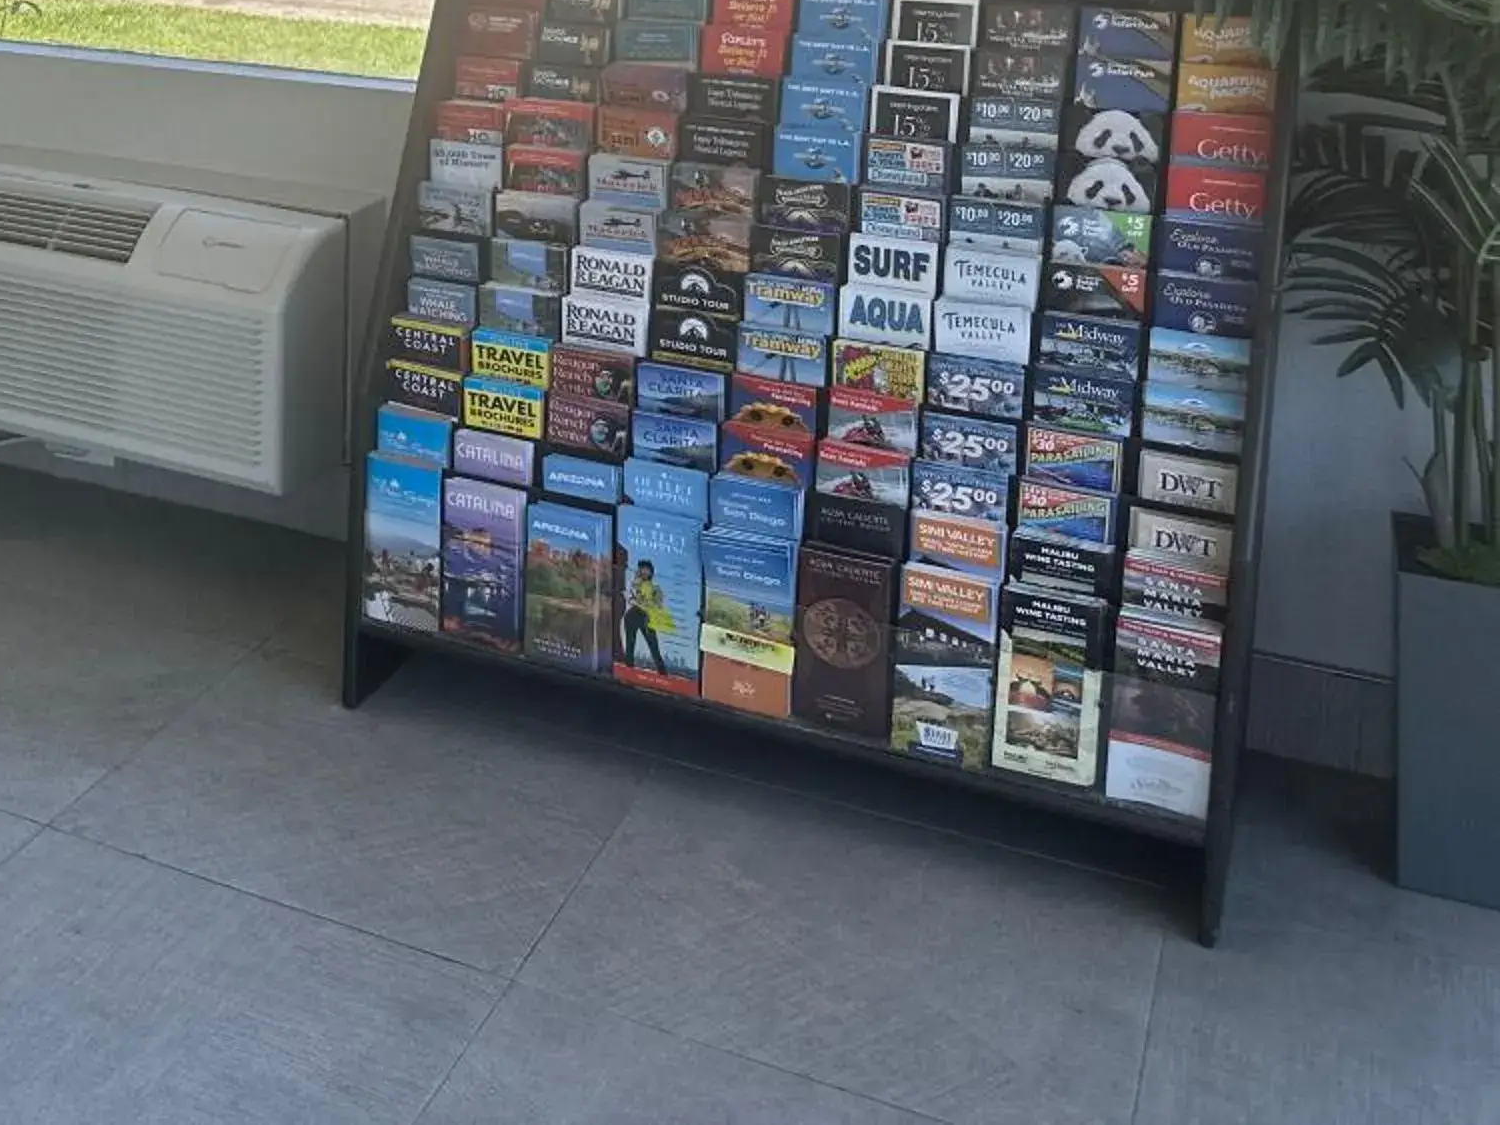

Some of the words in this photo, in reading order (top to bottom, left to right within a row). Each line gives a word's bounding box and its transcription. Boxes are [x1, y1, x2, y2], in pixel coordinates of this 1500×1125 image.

[1189, 192, 1259, 219] Getty
[576, 254, 645, 276] RONALD
[854, 244, 930, 281] SURF
[954, 259, 1026, 284] TEMECULA
[575, 274, 644, 295] REAGAN
[747, 282, 825, 307] Tramway
[971, 279, 1013, 291] VALLEY
[661, 294, 699, 306] STUDIO
[701, 297, 729, 310] TOUR
[566, 304, 636, 326] RONALD
[850, 294, 924, 334] AQUA
[942, 312, 1016, 334] TEMECULA
[395, 327, 456, 347] CENTRAL
[567, 322, 636, 342] REAGAN
[1067, 323, 1125, 344] Midway
[404, 339, 448, 355] COAST
[659, 339, 697, 351] STUDIO
[699, 344, 727, 358] TOUR
[740, 332, 821, 357] Tramway
[476, 344, 545, 370] TRAVEL
[478, 360, 543, 379] BROCHURES
[395, 370, 455, 392] CENTRAL
[402, 381, 446, 400] COAST
[1059, 377, 1120, 399] Midway
[467, 391, 537, 418] TRAVEL
[469, 408, 535, 428] BROCHURES
[456, 443, 524, 467] CATALINA
[1160, 472, 1224, 499] DWT
[447, 492, 515, 519] CATALINA
[947, 530, 995, 548] VALLEY
[1155, 530, 1219, 557] DWT
[1025, 553, 1051, 563] WINE
[1053, 557, 1095, 572] TASTING
[1041, 546, 1079, 560] MALIBU
[937, 583, 985, 602] VALLEY
[1145, 576, 1203, 596] SANTA
[1031, 600, 1071, 614] MALIBU
[1143, 588, 1202, 608] MARIA
[1143, 598, 1203, 618] VALLEY
[1016, 606, 1044, 619] WINE
[1044, 612, 1087, 627] TASTING
[1136, 637, 1196, 657] SANTA
[1137, 649, 1196, 668] MARIA
[1137, 658, 1197, 678] VALLEY
